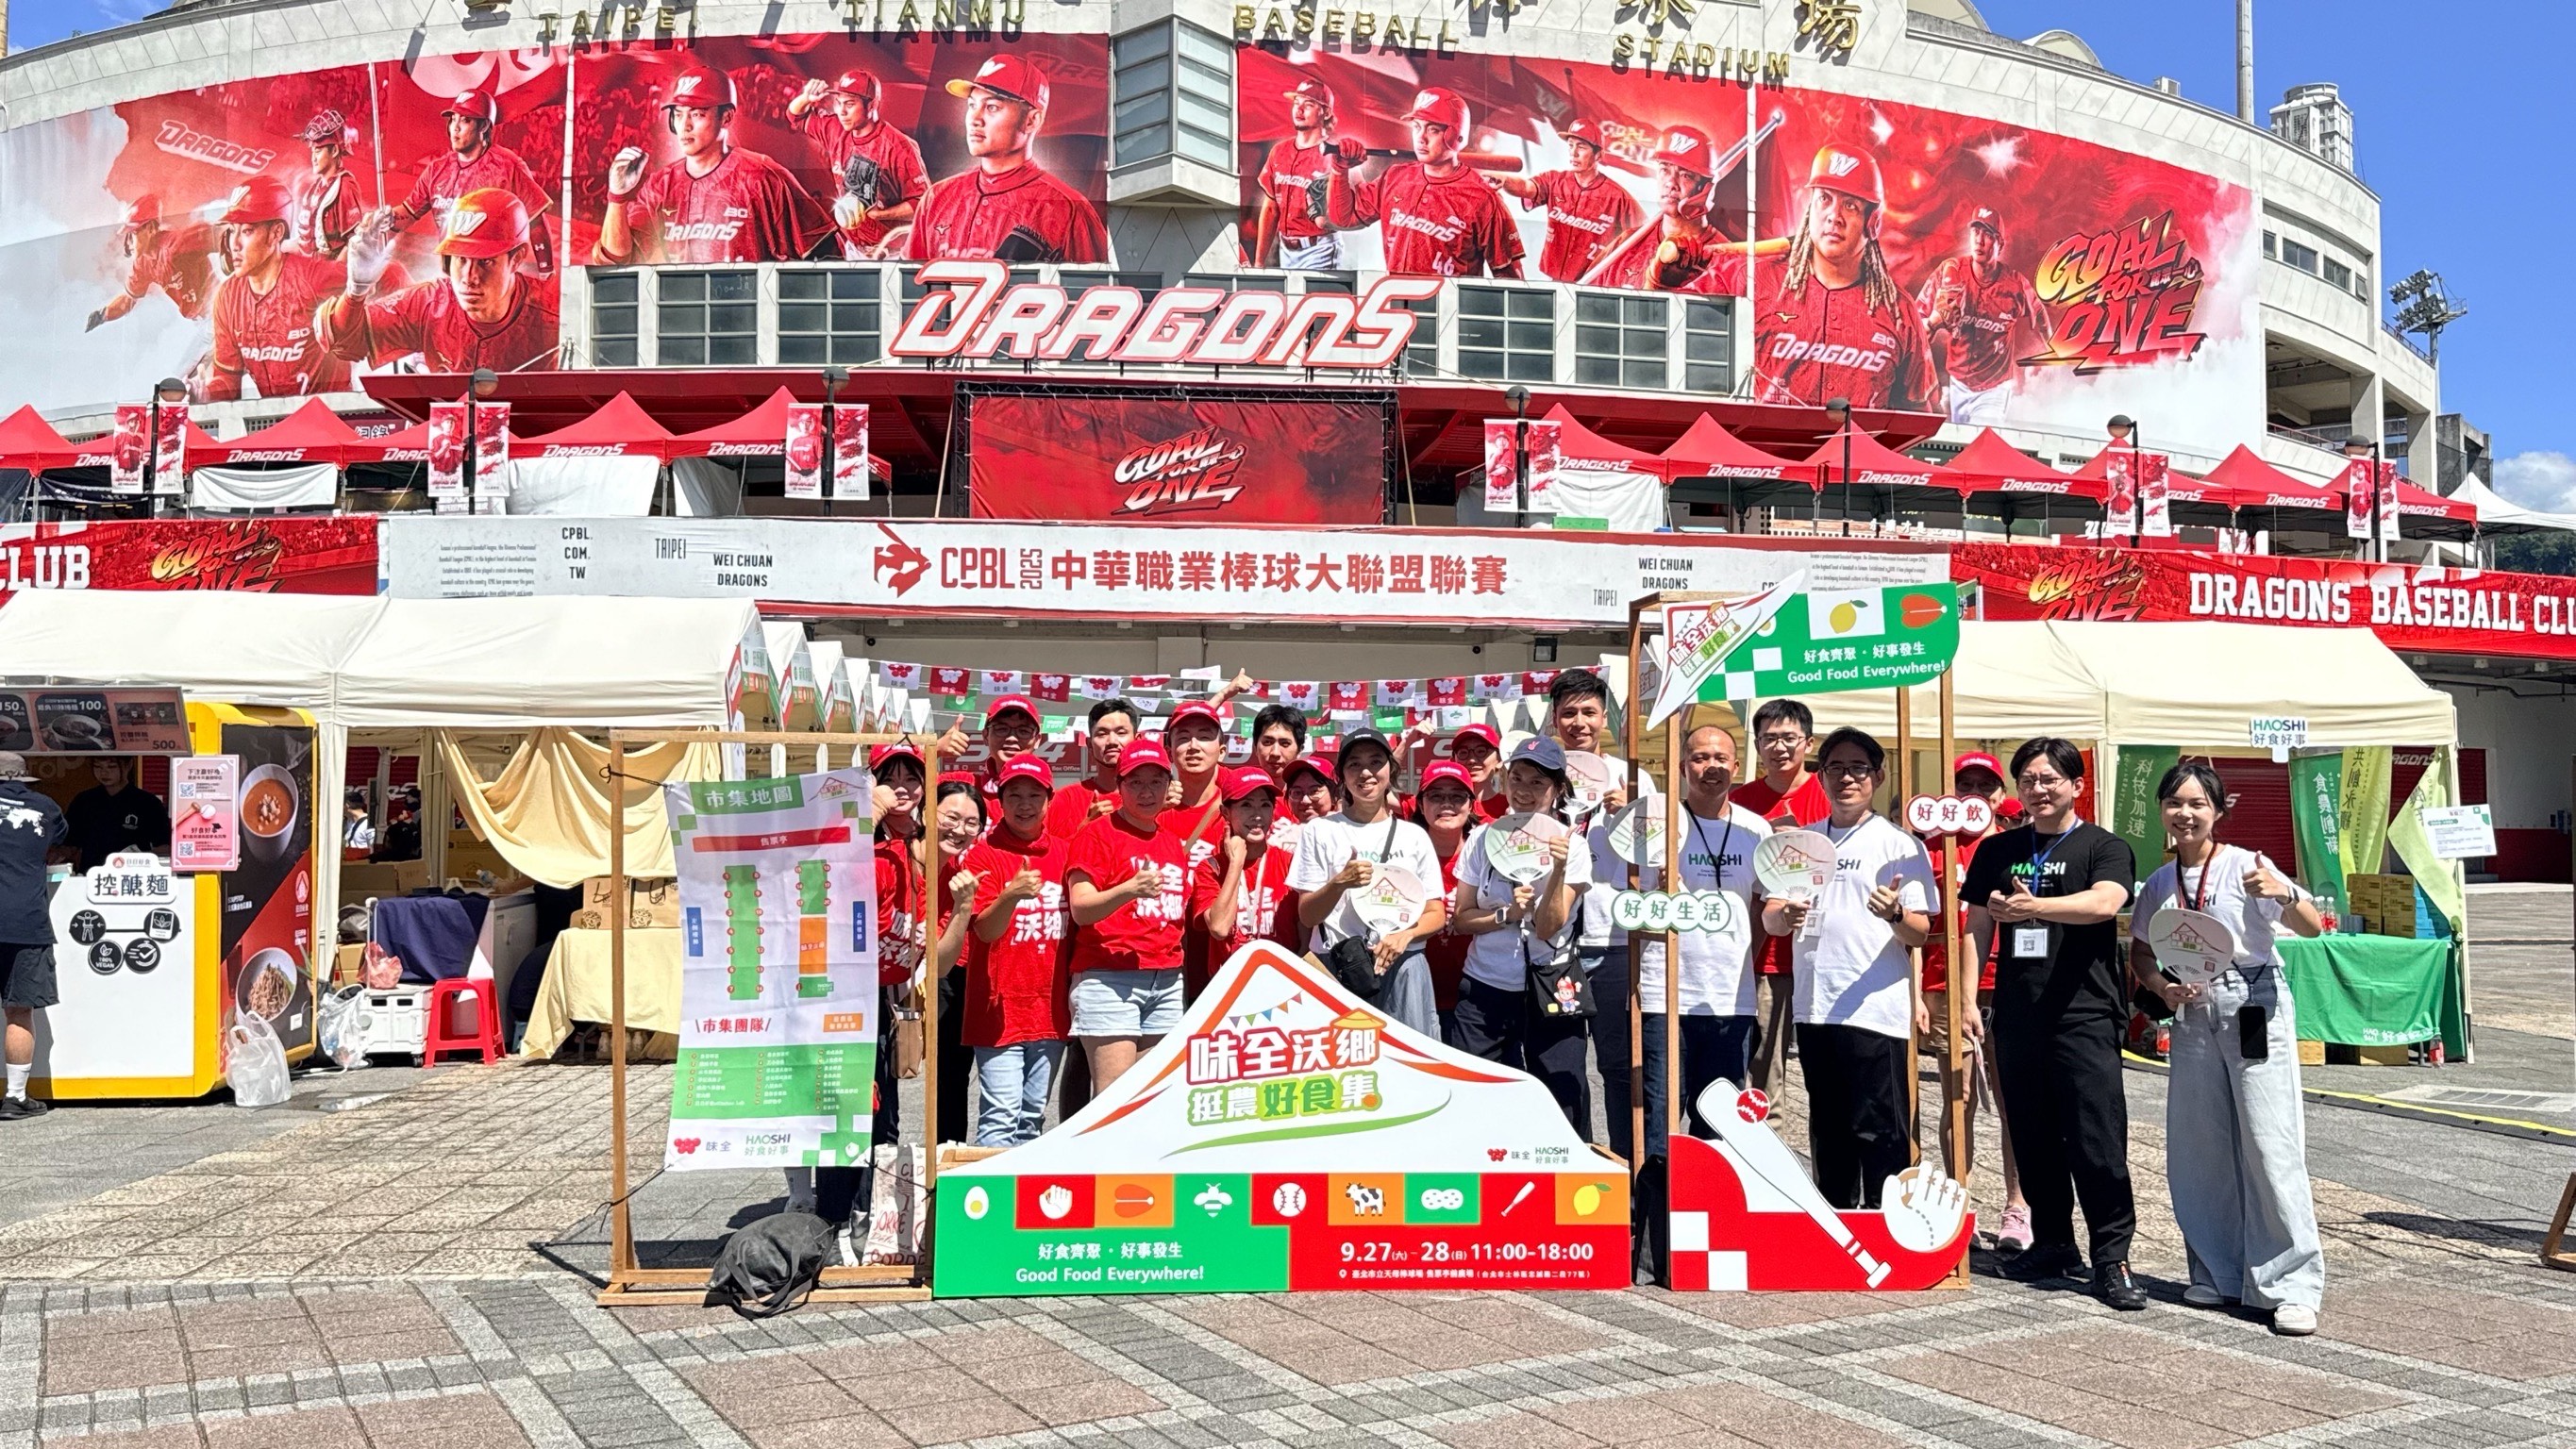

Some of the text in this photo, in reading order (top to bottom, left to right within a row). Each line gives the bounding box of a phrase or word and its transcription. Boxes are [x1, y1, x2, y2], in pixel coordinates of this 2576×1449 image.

[538, 6, 699, 38] TAIPEI
[847, 0, 1025, 25] TIANMU
[1234, 5, 1790, 78] BASEBALL STADIUM
[153, 119, 276, 175] DRAGONS
[1390, 208, 1463, 243] DRAGONS
[1548, 206, 1612, 236] DRAGONS
[1431, 251, 1454, 277] 46
[2035, 209, 2188, 305] GOAL
[2088, 269, 2157, 306] FOR
[890, 258, 1446, 368] DRAGONS
[2048, 281, 2208, 358] ONE
[1771, 332, 1892, 374] DRAGONS
[227, 447, 307, 463] DRAGONS
[543, 442, 627, 458] DRAGONS
[1114, 425, 1229, 485] GOAL
[1151, 461, 1202, 482] FOR
[1706, 463, 1786, 479] DRAGONS
[1857, 470, 1933, 486] DRAGONS
[1123, 458, 1246, 511] ONE
[2000, 477, 2073, 493] DRAGONS
[2267, 493, 2331, 509] DRAGONS
[151, 520, 267, 580] GOAL
[655, 538, 687, 559] TAIPEI
[713, 553, 773, 568] WEI CHUAN
[941, 547, 1015, 590] CPBL
[1020, 547, 1043, 590] 2025
[1638, 557, 1694, 572] WEI CHUAN
[569, 566, 586, 579] TW
[717, 573, 769, 587] DRAGONS
[1050, 549, 1508, 596] 中華職業棒球大聯盟聯賽
[1642, 575, 1688, 591] DRAGONS
[2029, 547, 2128, 605] GOAL
[1593, 589, 1617, 608] TAIPEI
[2189, 572, 2352, 624] DRAGONS
[2370, 583, 2526, 633] BASEBALL
[1788, 659, 1946, 683] Good Food Everywhere!
[78, 700, 102, 711] 100
[2253, 719, 2306, 731] HAOSHI
[153, 740, 176, 750] 500
[2253, 733, 2307, 746] 好食好事
[704, 785, 794, 809] 市集地圖
[2126, 758, 2154, 839] 科技加速
[1916, 803, 1984, 823] 好好飲
[760, 835, 789, 848] 售票亭
[94, 873, 170, 897] 控醣麵
[1624, 898, 1722, 924] 好好生活
[1014, 910, 1070, 942] 沃鄉
[703, 1018, 764, 1034] 市集團隊
[1190, 1026, 1377, 1082] 味全沃鄉
[1192, 1074, 1377, 1123] 挺農好食集
[706, 1140, 731, 1153] 味全
[745, 1133, 791, 1144] HAOSHI
[744, 1145, 790, 1157] 好食好事
[1511, 1150, 1531, 1160] 味全
[1534, 1146, 1569, 1156] HAOSHI
[1535, 1156, 1569, 1164] 好食好事
[1470, 1242, 1594, 1261] 11:00-18:00
[1015, 1265, 1205, 1284] Good Food Everywhere!
